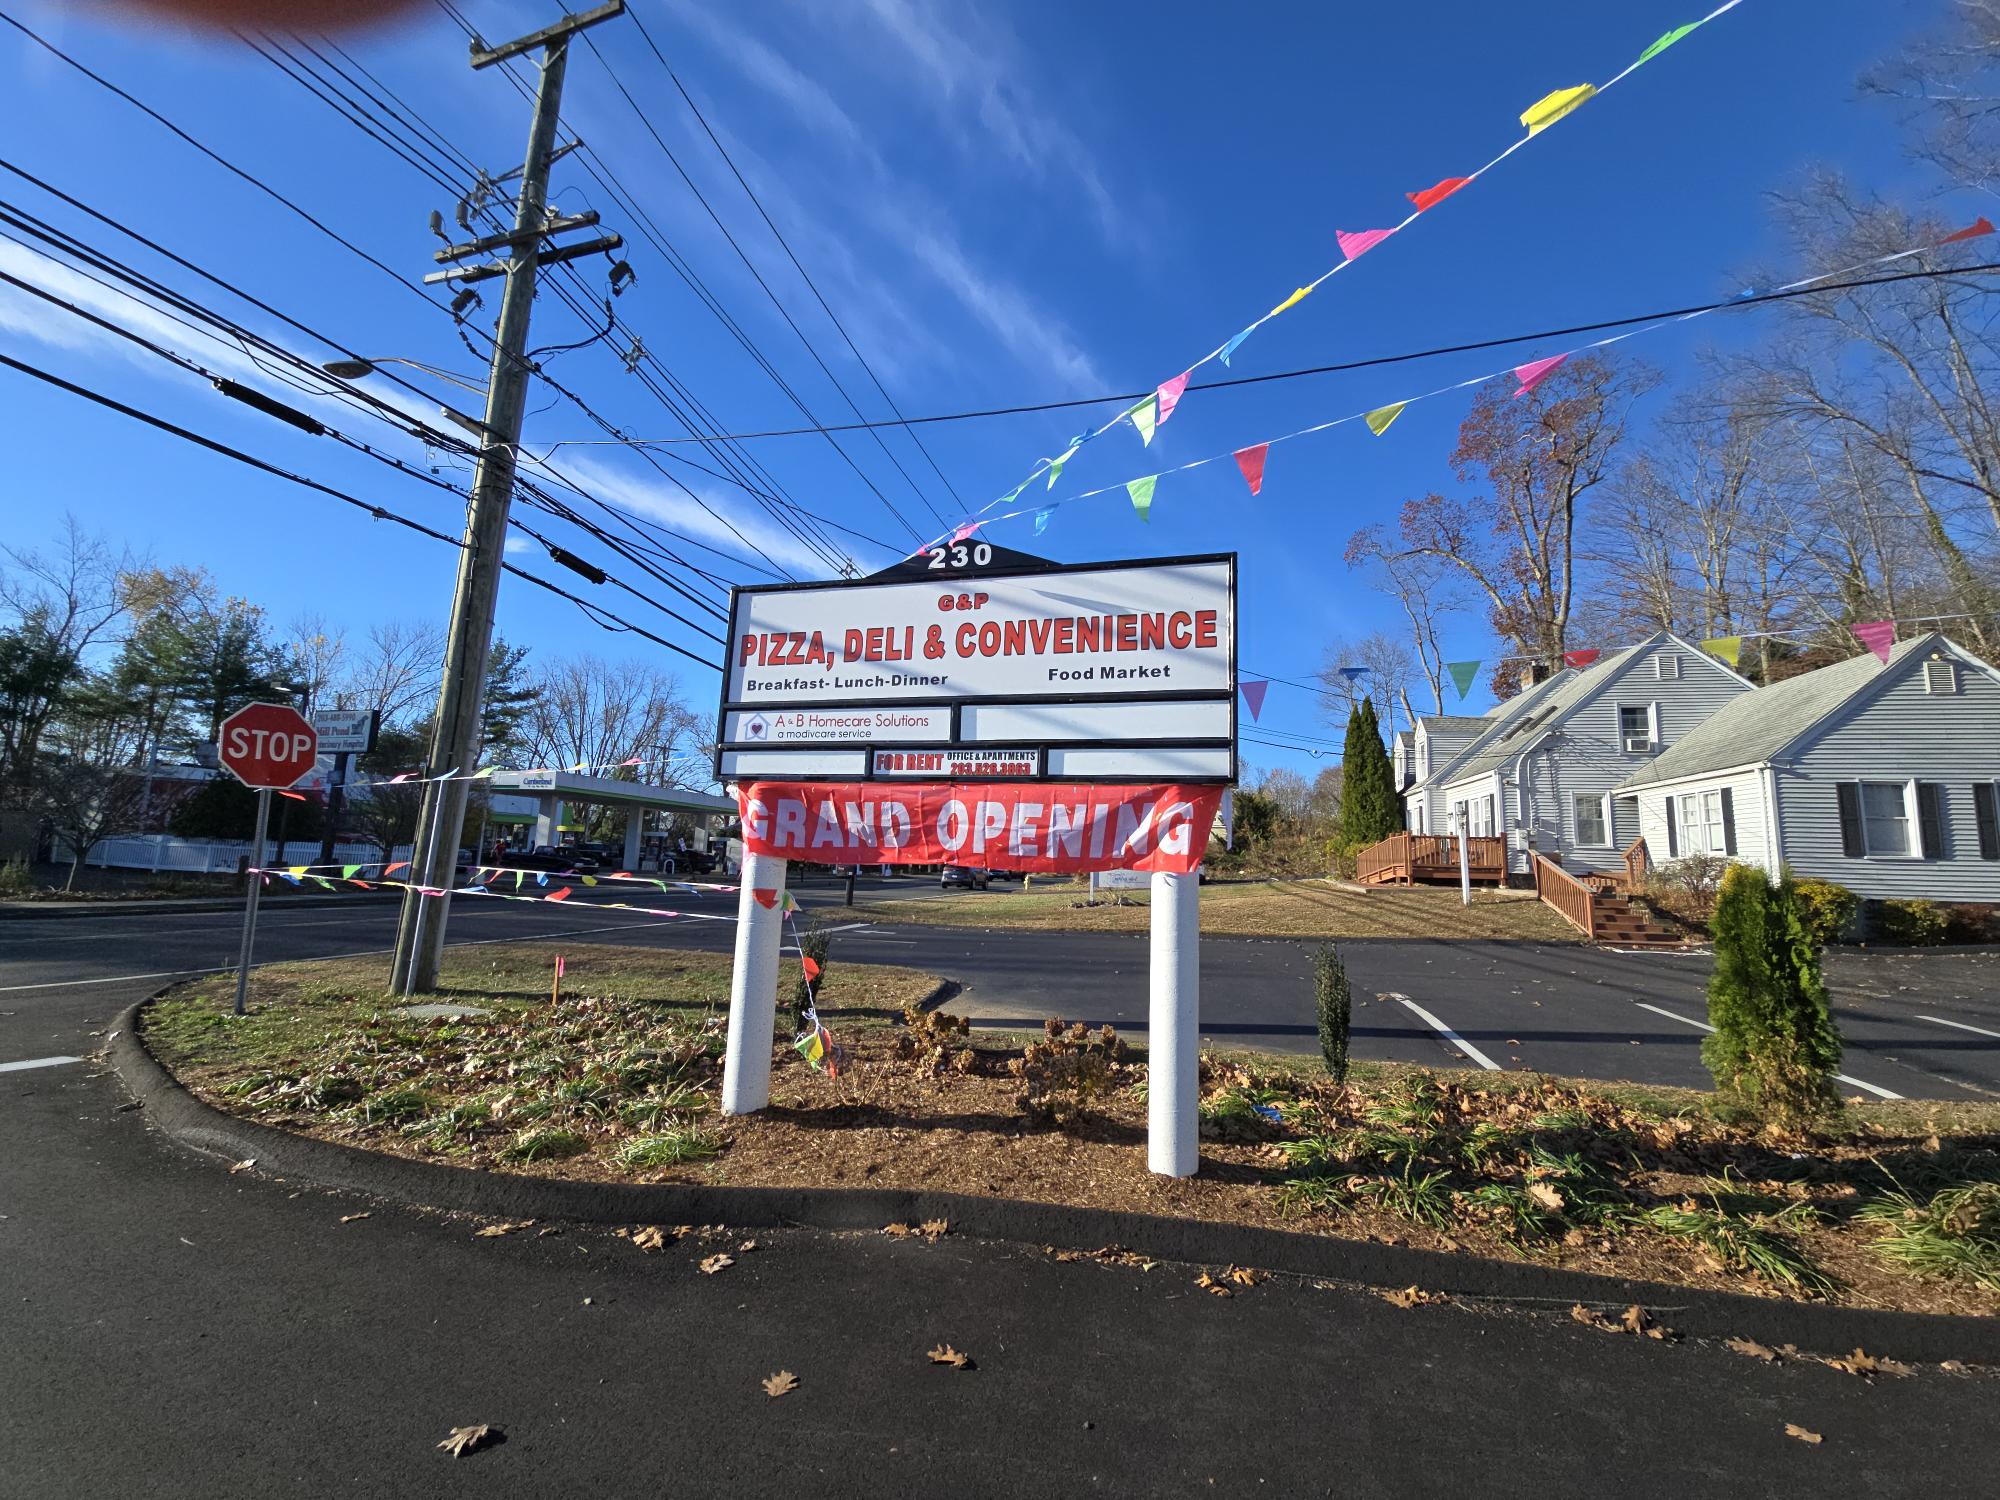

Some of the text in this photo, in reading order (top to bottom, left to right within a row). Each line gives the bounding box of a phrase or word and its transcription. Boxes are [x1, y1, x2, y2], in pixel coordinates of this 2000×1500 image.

[928, 544, 992, 570] 230
[937, 592, 990, 612] G&P
[739, 610, 1218, 671] PIZZA, DELI & CONVENIENCE
[1048, 665, 1171, 681] Food Market
[775, 714, 785, 728] A
[796, 714, 804, 727] B
[808, 714, 871, 727] Homecare
[875, 713, 929, 727] Solutions
[777, 729, 872, 739] a modivcare service
[227, 727, 312, 763] STOP
[875, 753, 945, 770] FOR RENT
[947, 752, 1036, 761] OFFICE & APARTMENTS
[744, 799, 1195, 859] GRAND OPENING
